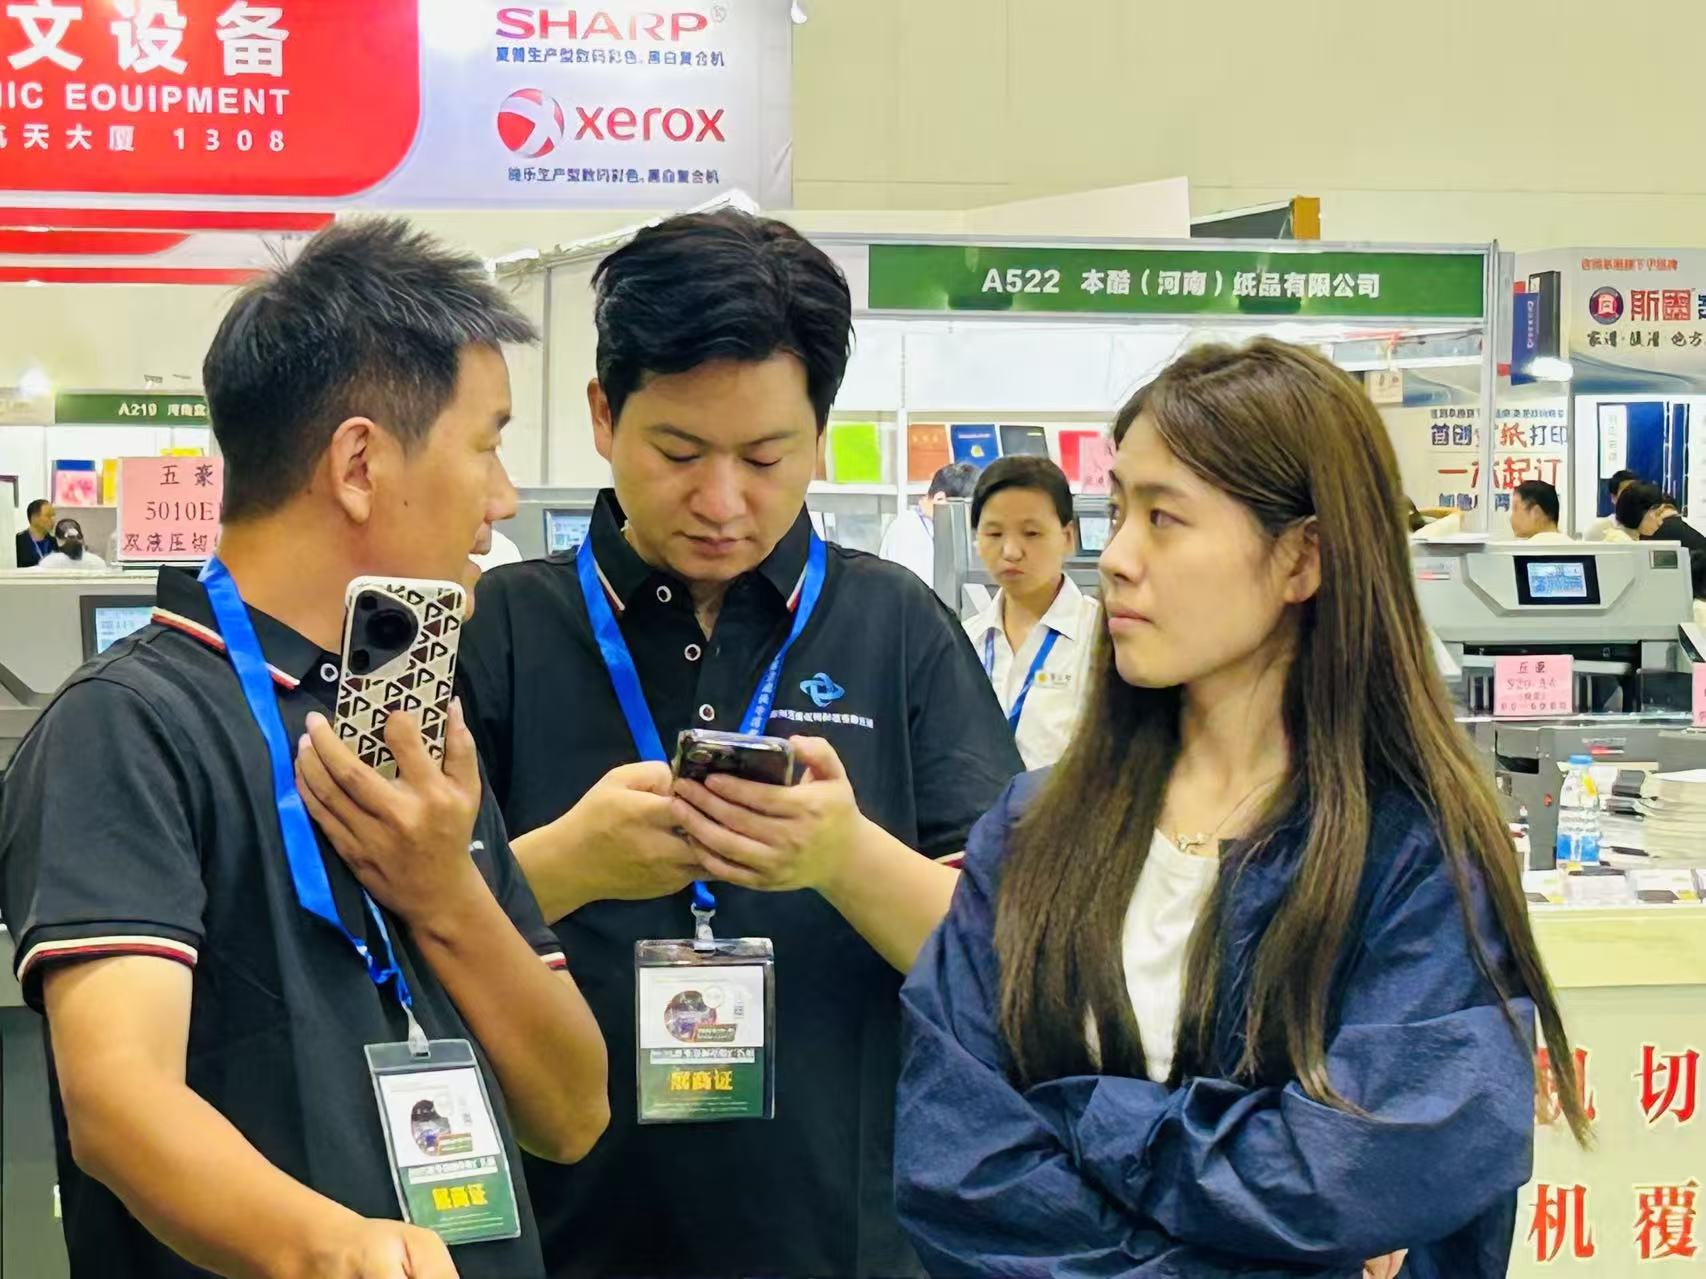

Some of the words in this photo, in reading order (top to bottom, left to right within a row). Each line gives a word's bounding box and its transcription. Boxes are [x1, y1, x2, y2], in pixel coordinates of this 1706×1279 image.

[6, 0, 290, 77] 文设备
[496, 8, 708, 42] SHARP
[0, 80, 44, 110] IC
[173, 127, 286, 152] 1308
[575, 106, 725, 143] xerox
[981, 268, 1061, 294] A522
